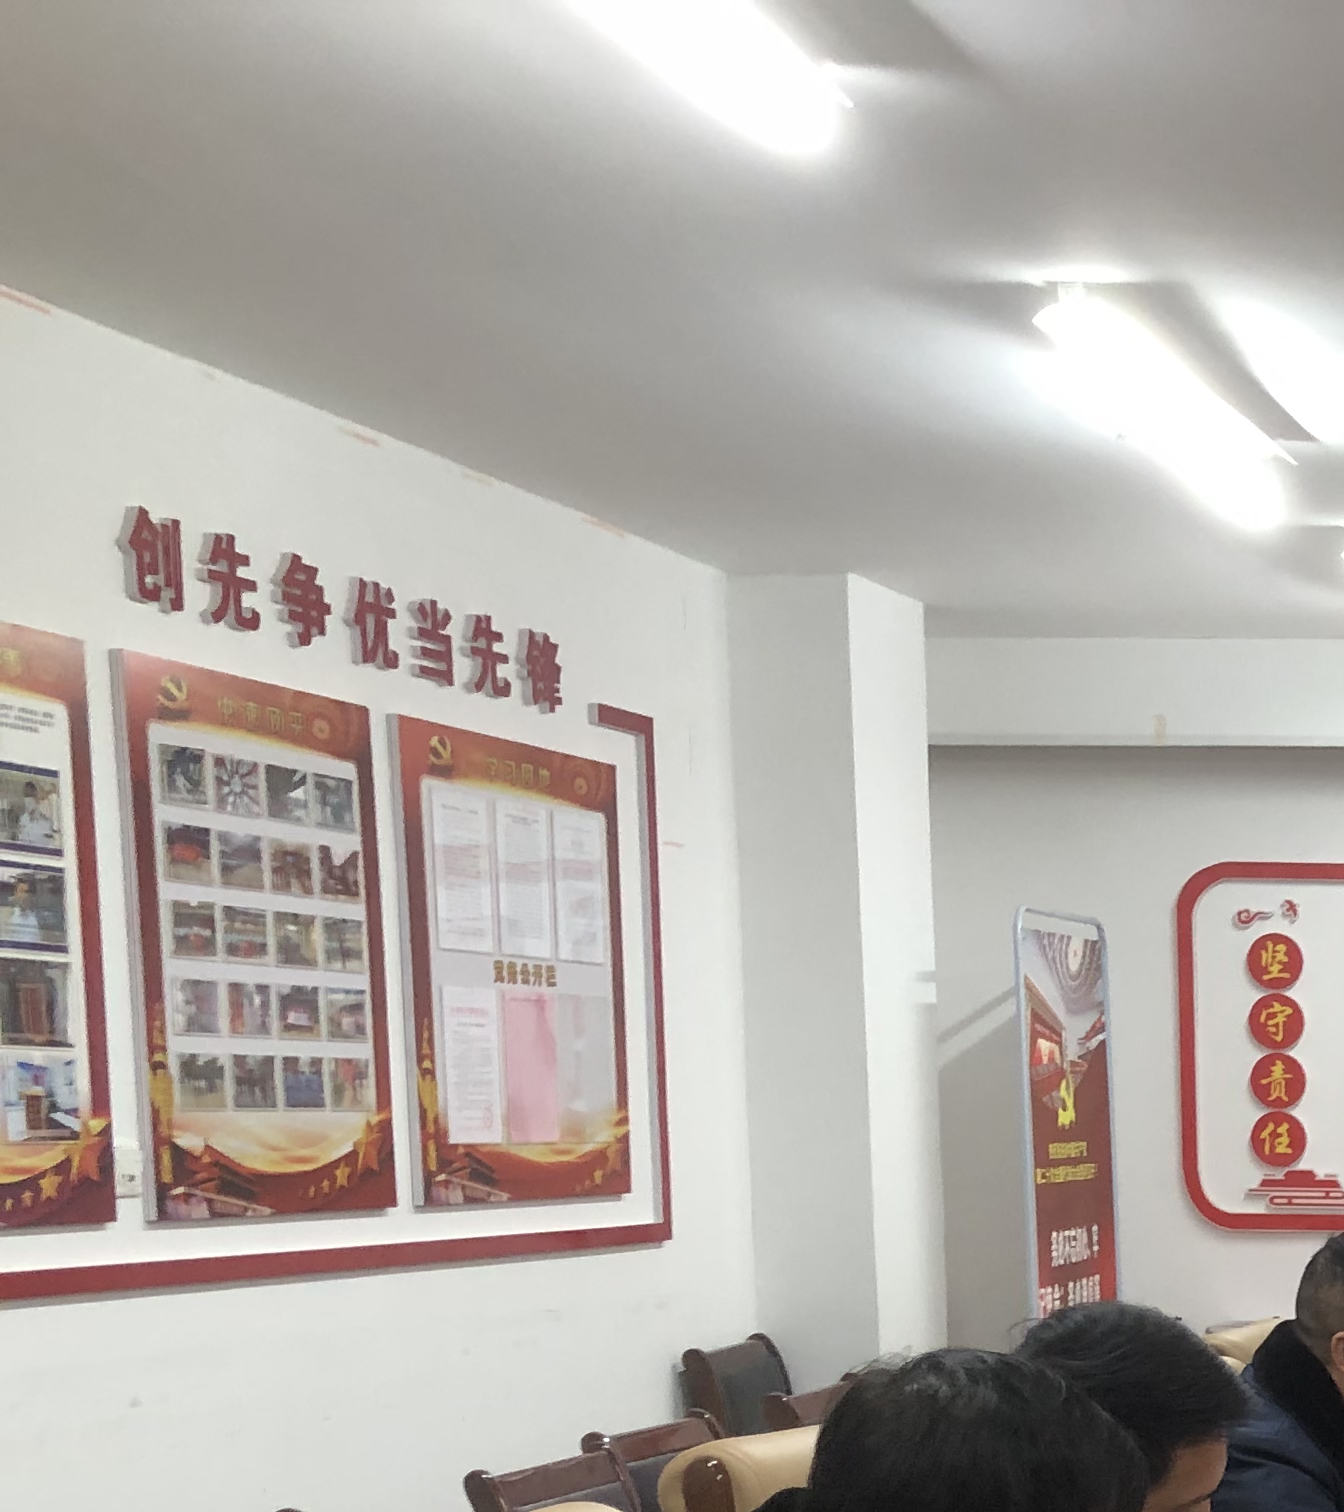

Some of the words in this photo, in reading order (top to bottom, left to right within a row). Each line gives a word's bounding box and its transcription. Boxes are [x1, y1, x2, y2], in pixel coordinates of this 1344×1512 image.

[118, 505, 563, 713] 创先争优当先锋
[488, 757, 551, 789] 学习园地
[1259, 940, 1294, 1156] 坚守责任
